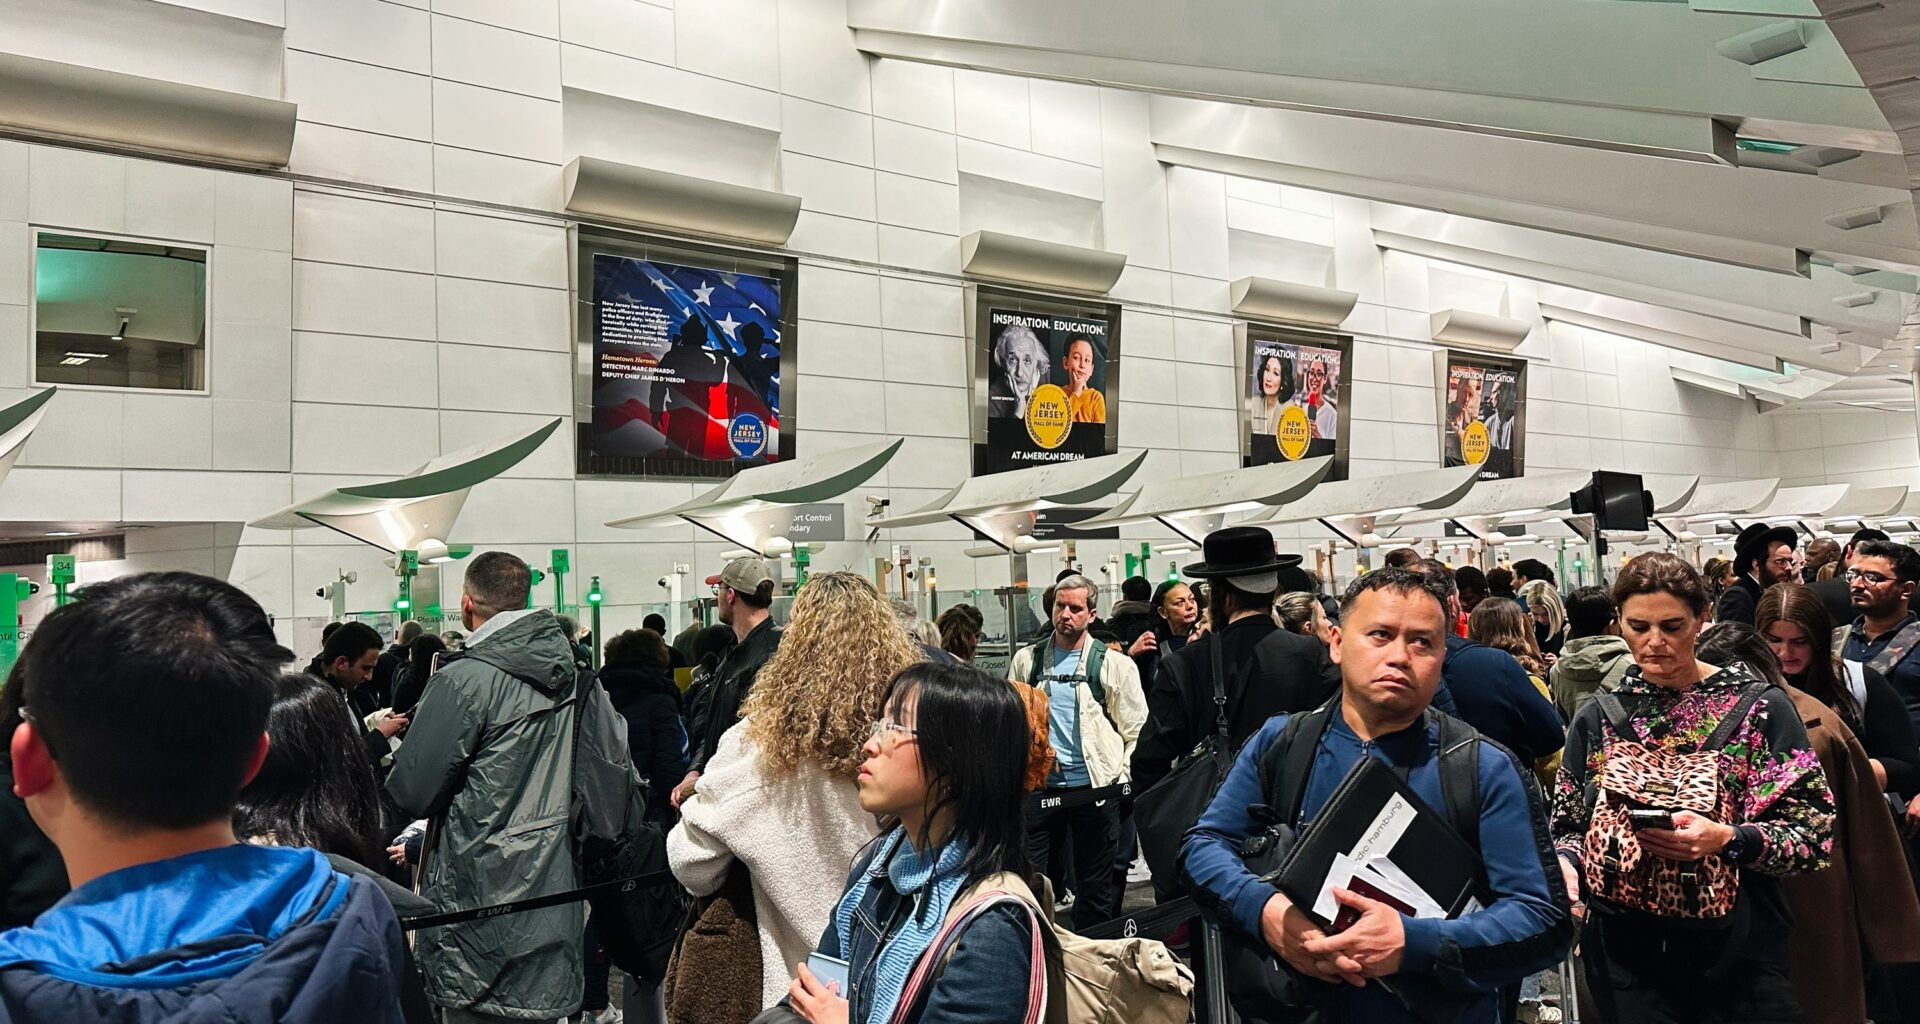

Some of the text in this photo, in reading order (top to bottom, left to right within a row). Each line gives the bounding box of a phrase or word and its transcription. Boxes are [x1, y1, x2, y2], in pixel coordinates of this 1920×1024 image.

[992, 314, 1105, 336] INSPIRATION. EDUCATION.
[602, 353, 658, 364] Hometown Heroes:
[602, 363, 630, 371] DETECTIVE
[648, 367, 676, 375] DINARDO
[1040, 402, 1058, 410] NEW
[1034, 410, 1064, 419] JERSEY
[1011, 451, 1085, 461] AT AMERICAN DREAM
[805, 512, 832, 522] Control
[57, 562, 70, 570] 34
[418, 614, 444, 623] Please
[982, 660, 1006, 669] Closed
[1041, 797, 1062, 808] EWR
[1367, 800, 1403, 845] hamburg
[476, 904, 512, 918] EWR
